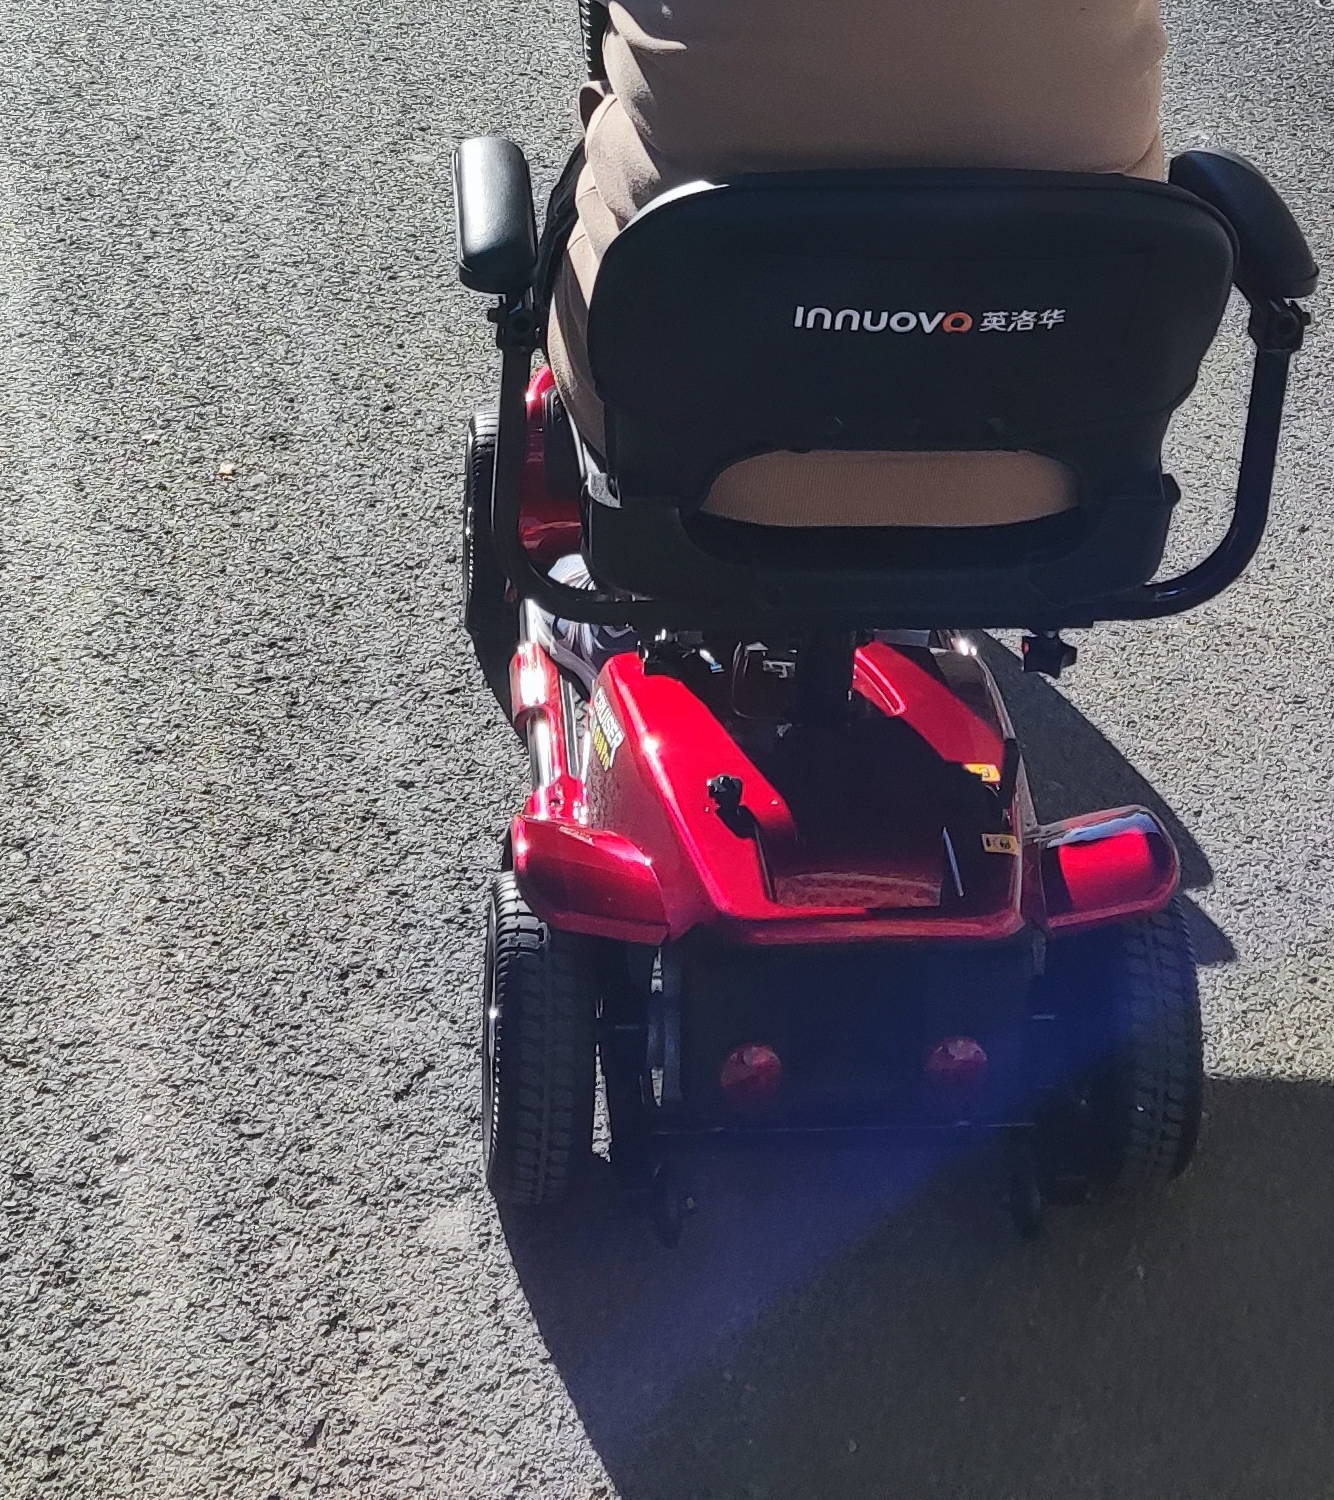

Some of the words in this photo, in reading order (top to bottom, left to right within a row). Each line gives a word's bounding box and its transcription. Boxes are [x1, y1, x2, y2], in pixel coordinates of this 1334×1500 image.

[978, 308, 1066, 332] 英洛华
[593, 686, 625, 766] CRUISER
